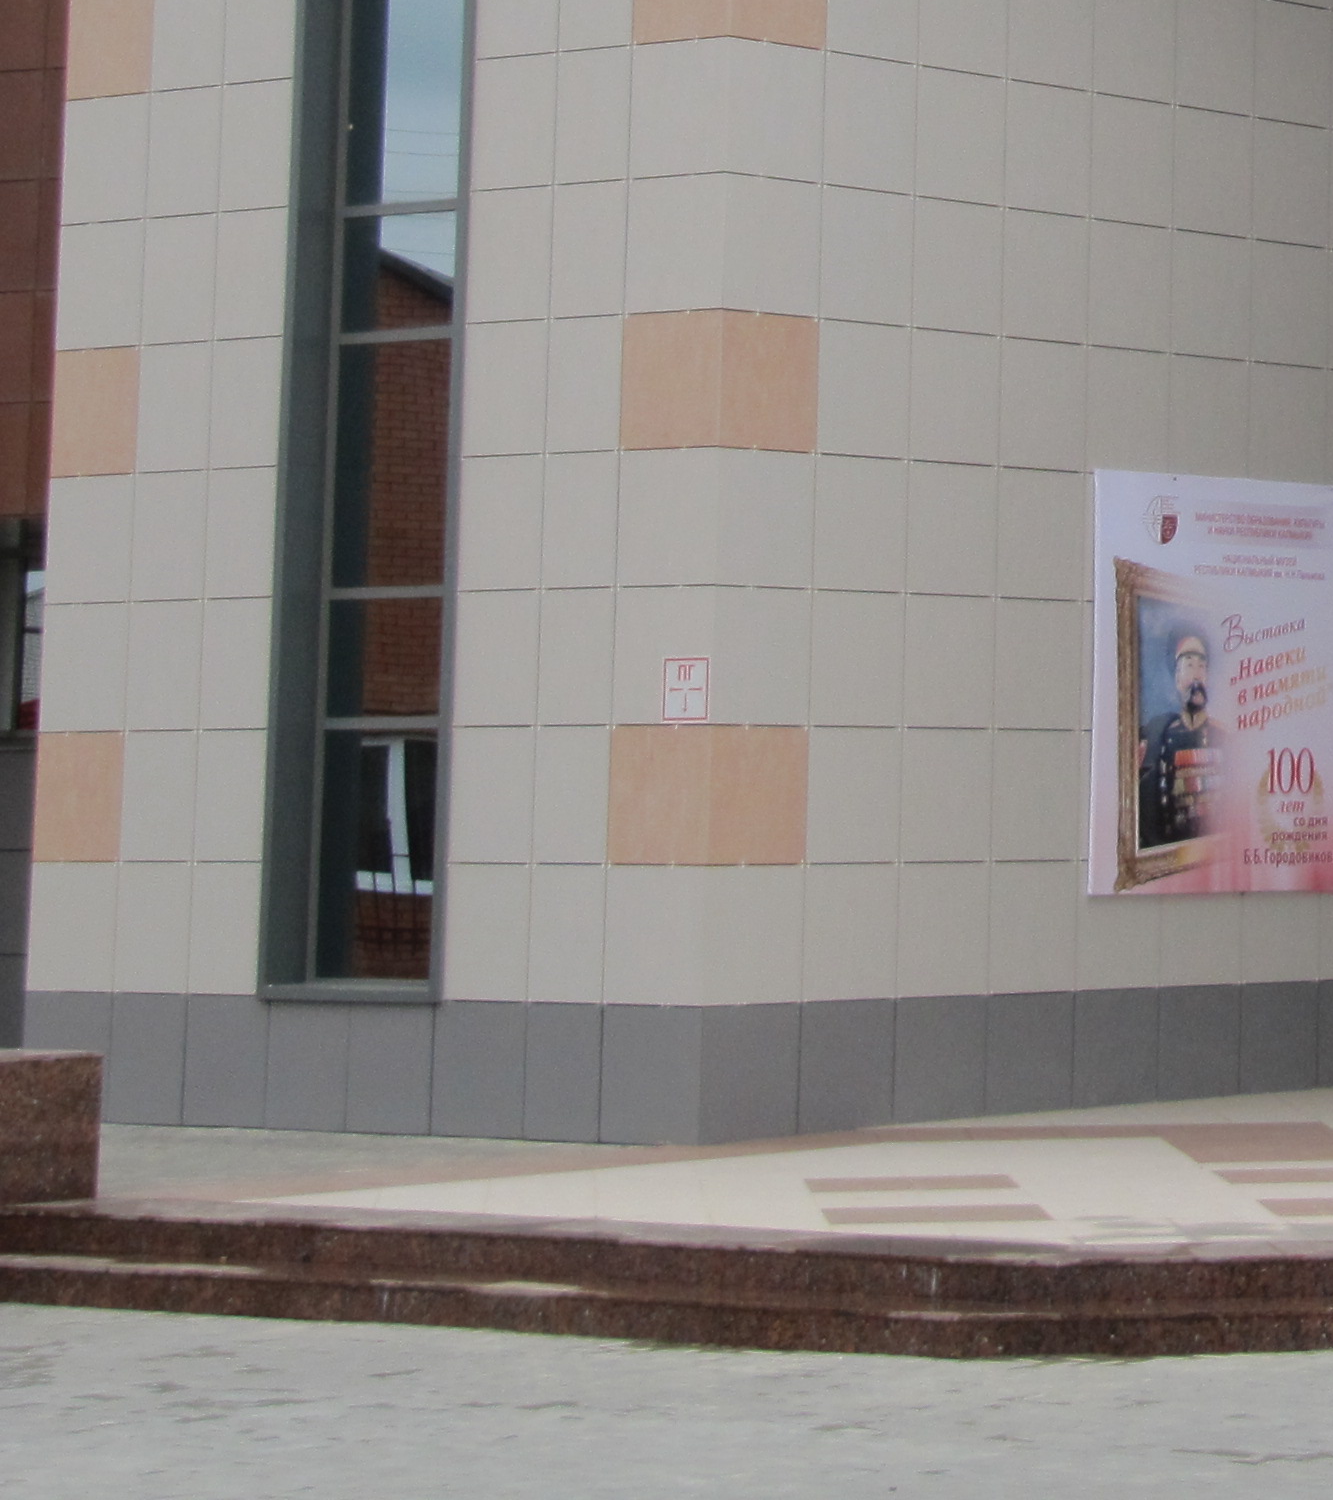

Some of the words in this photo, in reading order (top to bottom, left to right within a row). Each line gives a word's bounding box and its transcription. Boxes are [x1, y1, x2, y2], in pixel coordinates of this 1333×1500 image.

[1220, 613, 1306, 653] Выставка
[678, 664, 696, 681] ПГ
[1268, 747, 1314, 794] 100
[1277, 800, 1304, 812] лет
[1293, 817, 1306, 827] со
[1308, 816, 1328, 827] дня
[1272, 831, 1328, 844] рождения
